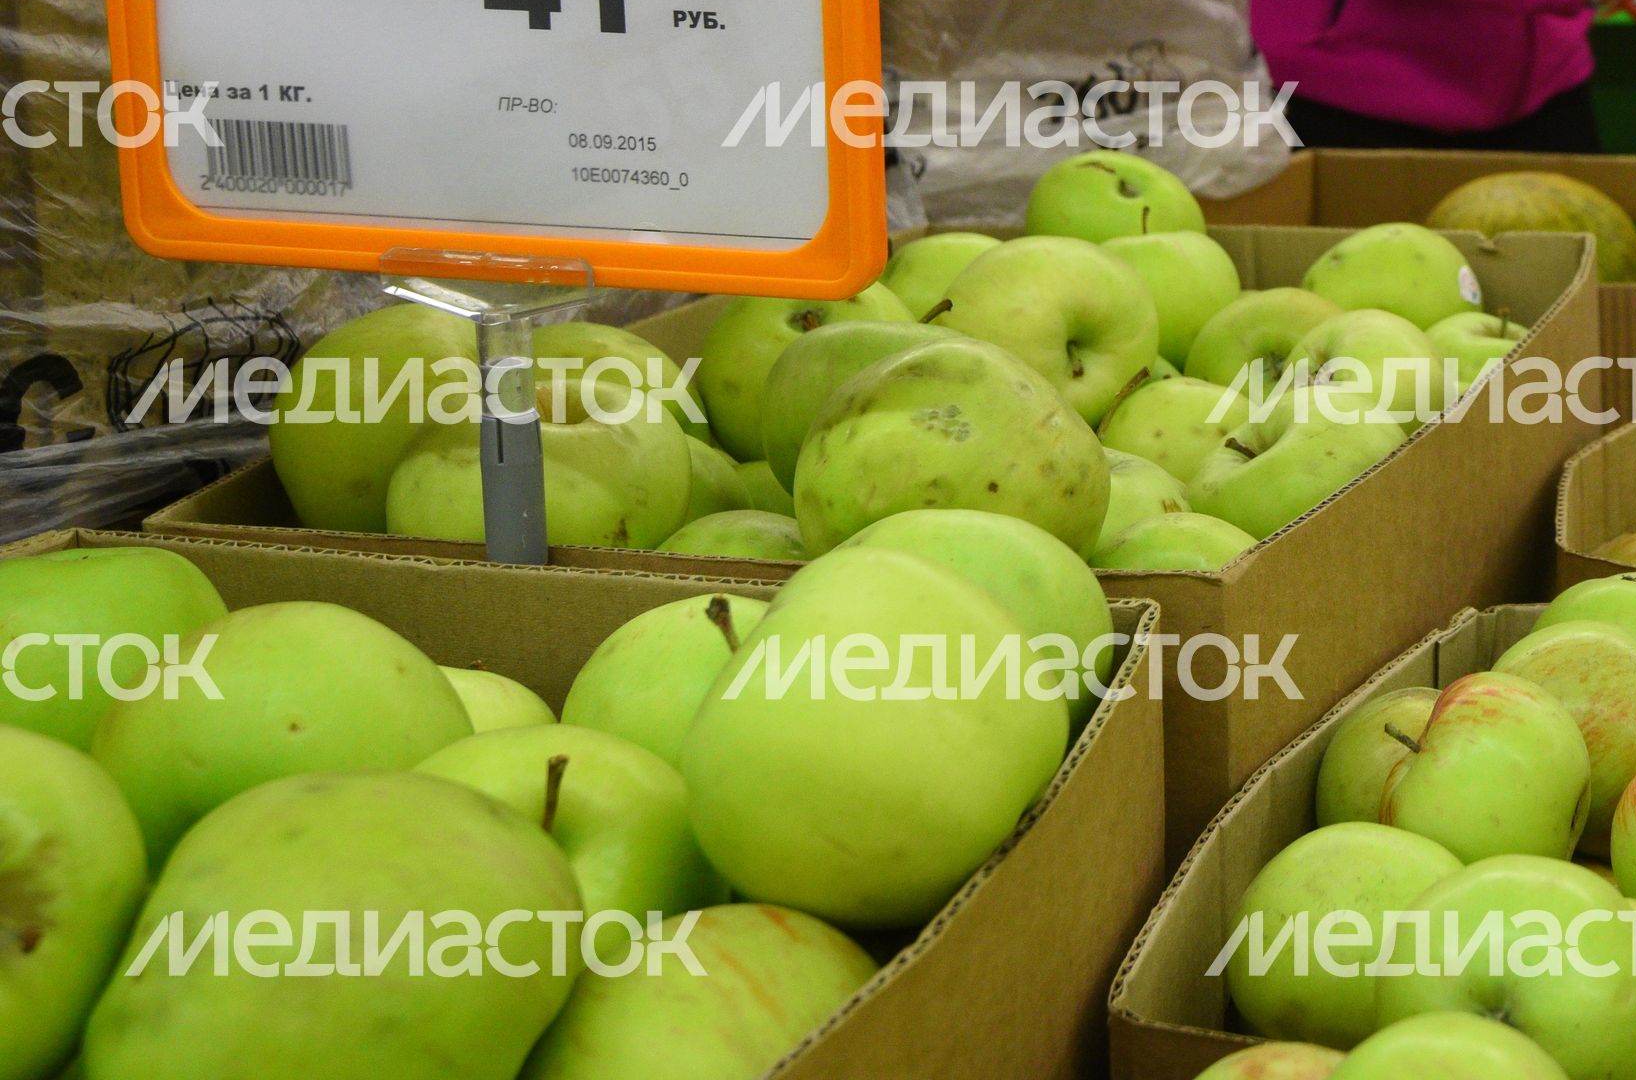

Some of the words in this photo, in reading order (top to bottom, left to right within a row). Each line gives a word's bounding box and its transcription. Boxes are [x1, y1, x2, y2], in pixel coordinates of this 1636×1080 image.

[673, 10, 726, 30] РУБ.
[164, 80, 219, 100] Цена
[227, 86, 252, 100] за
[259, 84, 268, 100] 1
[279, 85, 312, 103] КГ.
[498, 97, 557, 113] ПР-ВО:
[568, 133, 657, 151] 08.09.2015
